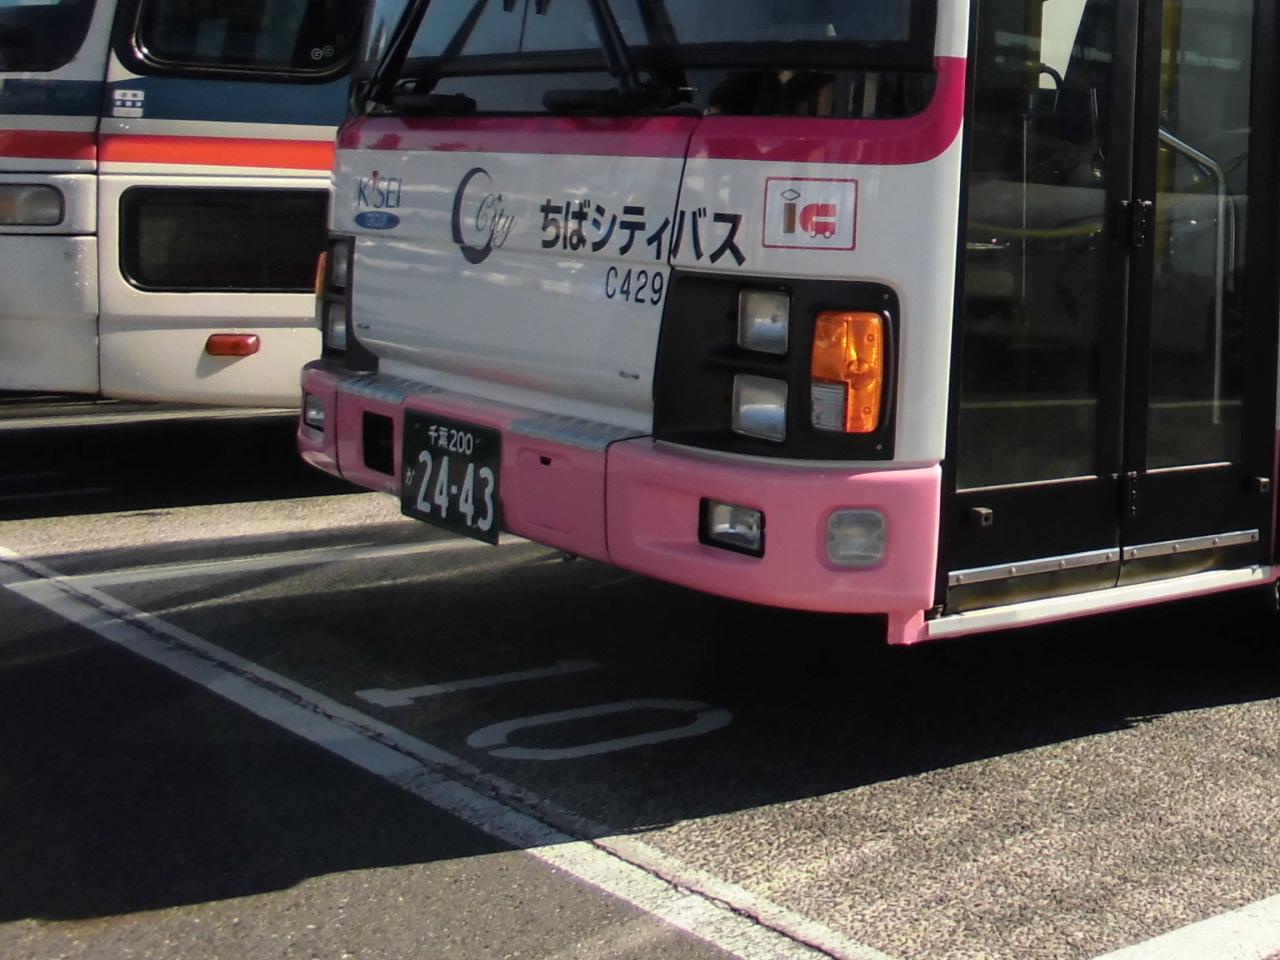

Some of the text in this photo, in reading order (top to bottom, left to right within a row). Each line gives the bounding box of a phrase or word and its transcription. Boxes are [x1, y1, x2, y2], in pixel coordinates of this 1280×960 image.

[540, 198, 746, 267] ちばシティバス
[605, 266, 664, 306] C429
